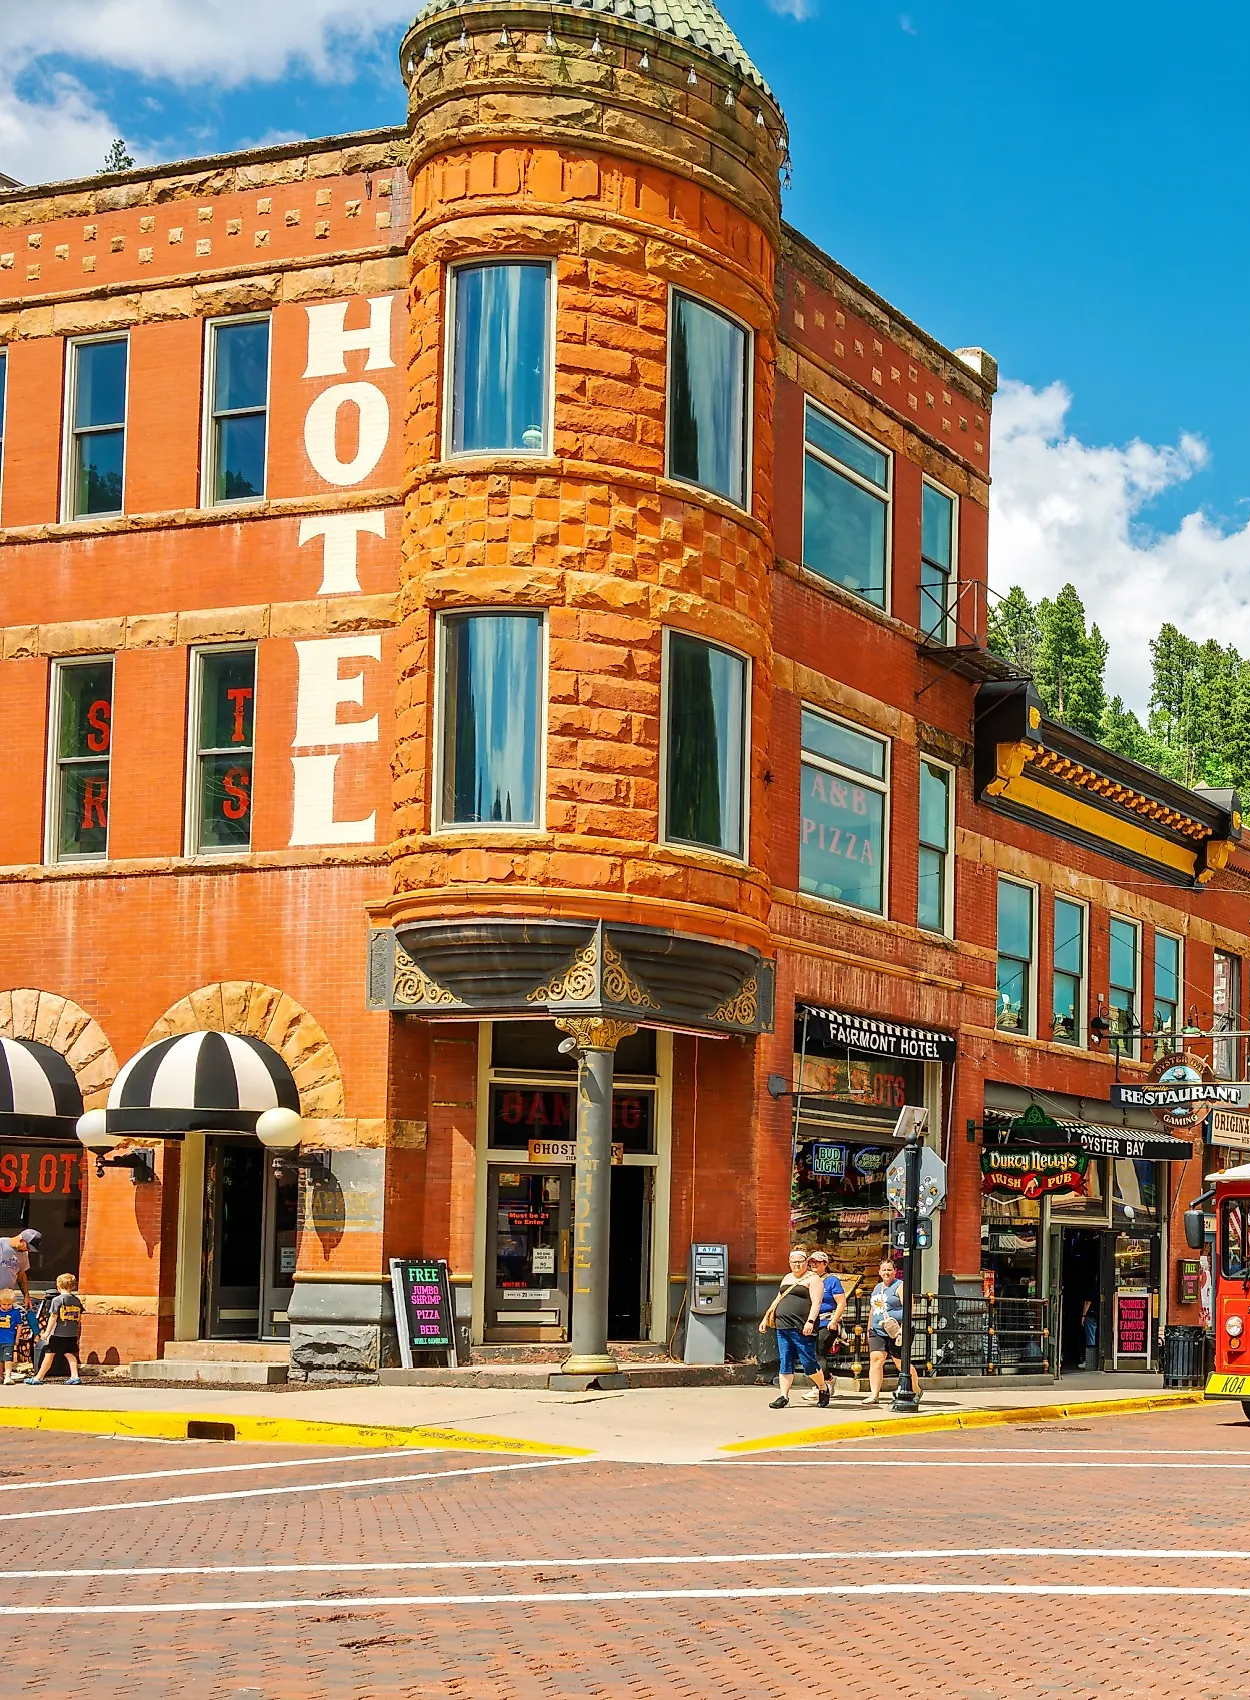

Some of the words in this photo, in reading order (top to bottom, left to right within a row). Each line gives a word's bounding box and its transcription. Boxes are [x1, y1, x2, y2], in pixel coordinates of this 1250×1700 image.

[288, 296, 396, 848] HOTEL
[811, 773, 867, 816] A&B
[802, 817, 874, 866] PIZZA
[829, 1022, 896, 1053] FAIRMONT
[900, 1038, 940, 1058] HOTEL
[1155, 1056, 1189, 1076] OYSTER
[850, 1069, 905, 1108] SLOTS
[1142, 1085, 1174, 1093] Family
[1120, 1085, 1241, 1106] RESTAURANT
[502, 1090, 641, 1130] GAMG
[1163, 1113, 1198, 1126] GAMING
[533, 1143, 577, 1155] GHOST
[1080, 1134, 1120, 1154] OYSTER
[1126, 1141, 1146, 1156] BAY
[819, 1147, 841, 1159] BUD
[814, 1160, 843, 1173] LIGHT
[991, 1173, 1021, 1188] IRISH
[1047, 1173, 1072, 1187] PUB
[574, 1174, 592, 1293] HOTEL
[408, 1268, 439, 1282] FREE
[412, 1286, 439, 1295] JUMBO
[411, 1295, 441, 1304] SHRIMP
[1120, 1300, 1146, 1309] RONNIES
[416, 1310, 440, 1319] PIZZA
[1121, 1309, 1144, 1319] WORLD
[420, 1325, 440, 1335] BEER
[1119, 1321, 1145, 1330] FAMOUS
[1120, 1331, 1144, 1340] OYSTER
[1122, 1341, 1143, 1351] SHOTS
[1221, 1377, 1247, 1393] KOA
